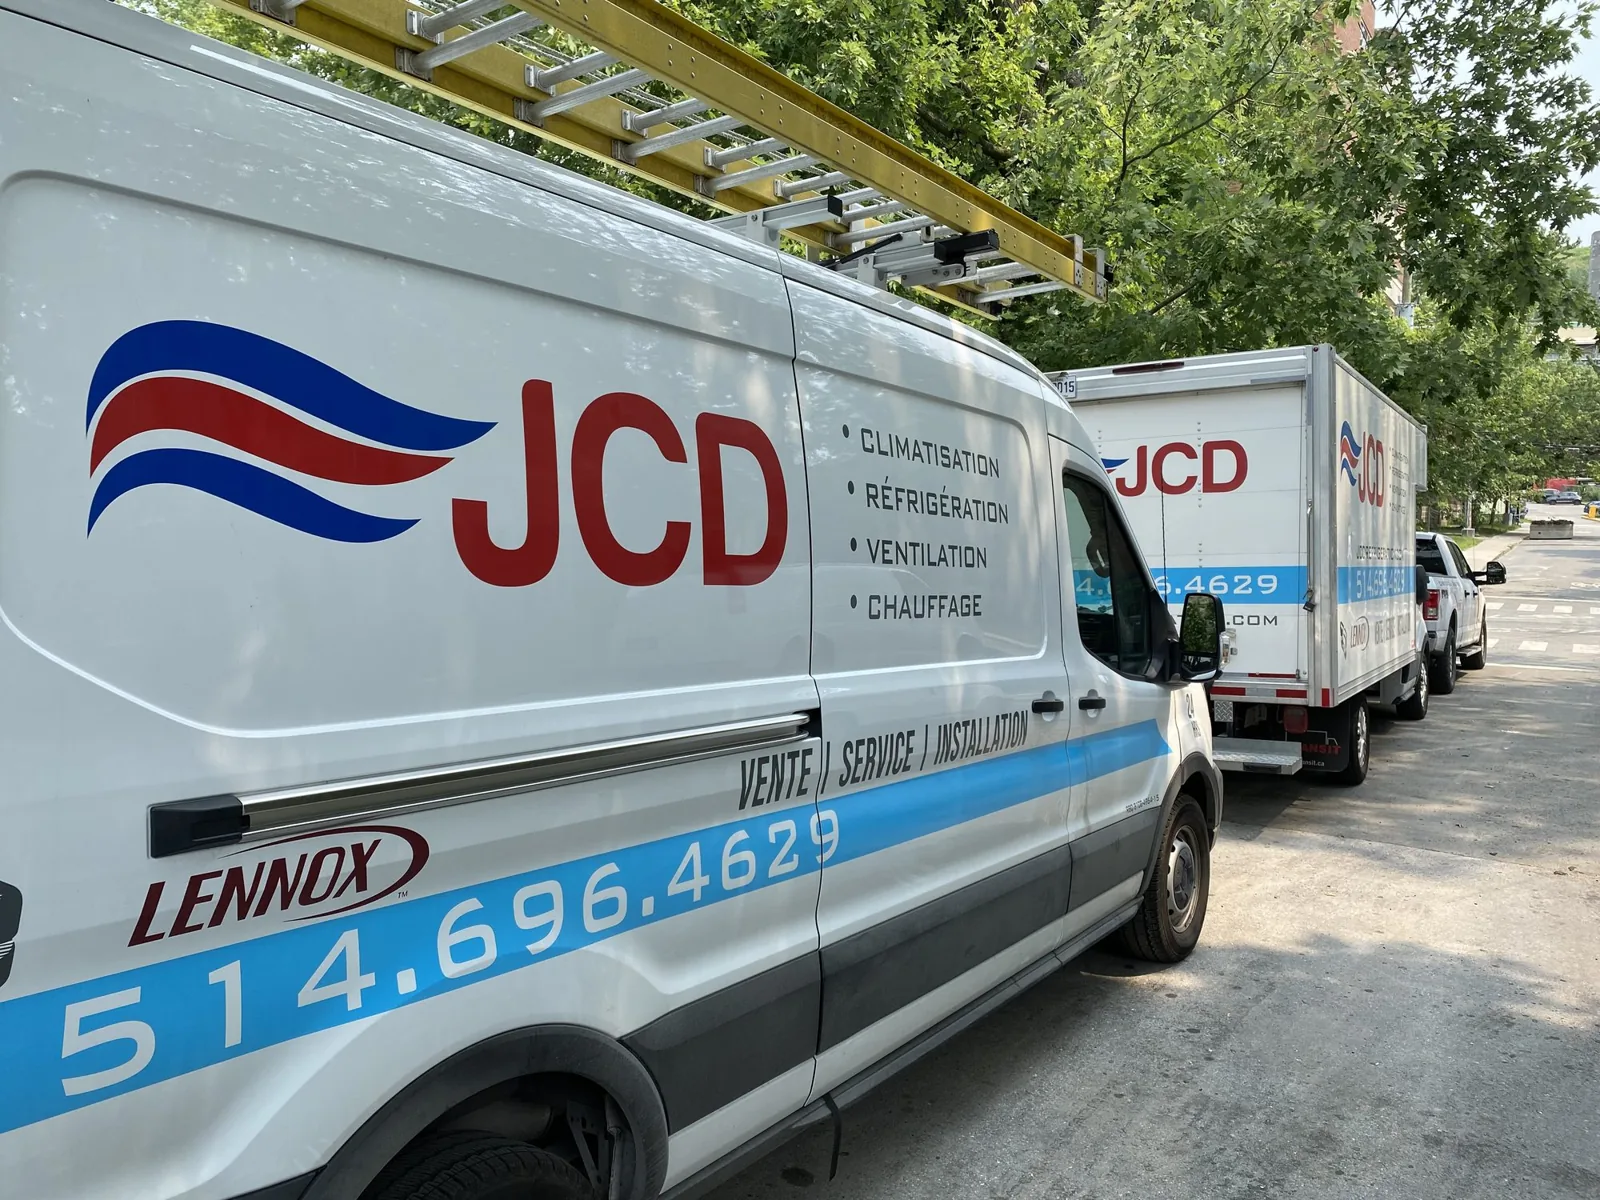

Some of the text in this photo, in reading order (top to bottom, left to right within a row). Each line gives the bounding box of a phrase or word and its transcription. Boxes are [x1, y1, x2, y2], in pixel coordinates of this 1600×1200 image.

[1053, 380, 1075, 393] 015
[860, 427, 1000, 479] CLIMATISATION
[1116, 440, 1248, 497] JCD
[1358, 431, 1385, 508] JCD
[452, 379, 788, 588] JCD
[865, 475, 1009, 525] RÉFRIGÉRATION
[866, 538, 987, 568] VENTILATION
[868, 594, 982, 620] CHAUFFAGE
[738, 747, 813, 811] VENTE
[838, 730, 916, 788] SERVICE
[933, 709, 1029, 766] INSTALLATION
[1303, 743, 1341, 755] ANSIT
[127, 838, 382, 948] LENNOX
[61, 809, 839, 1098] 514.696.4629
